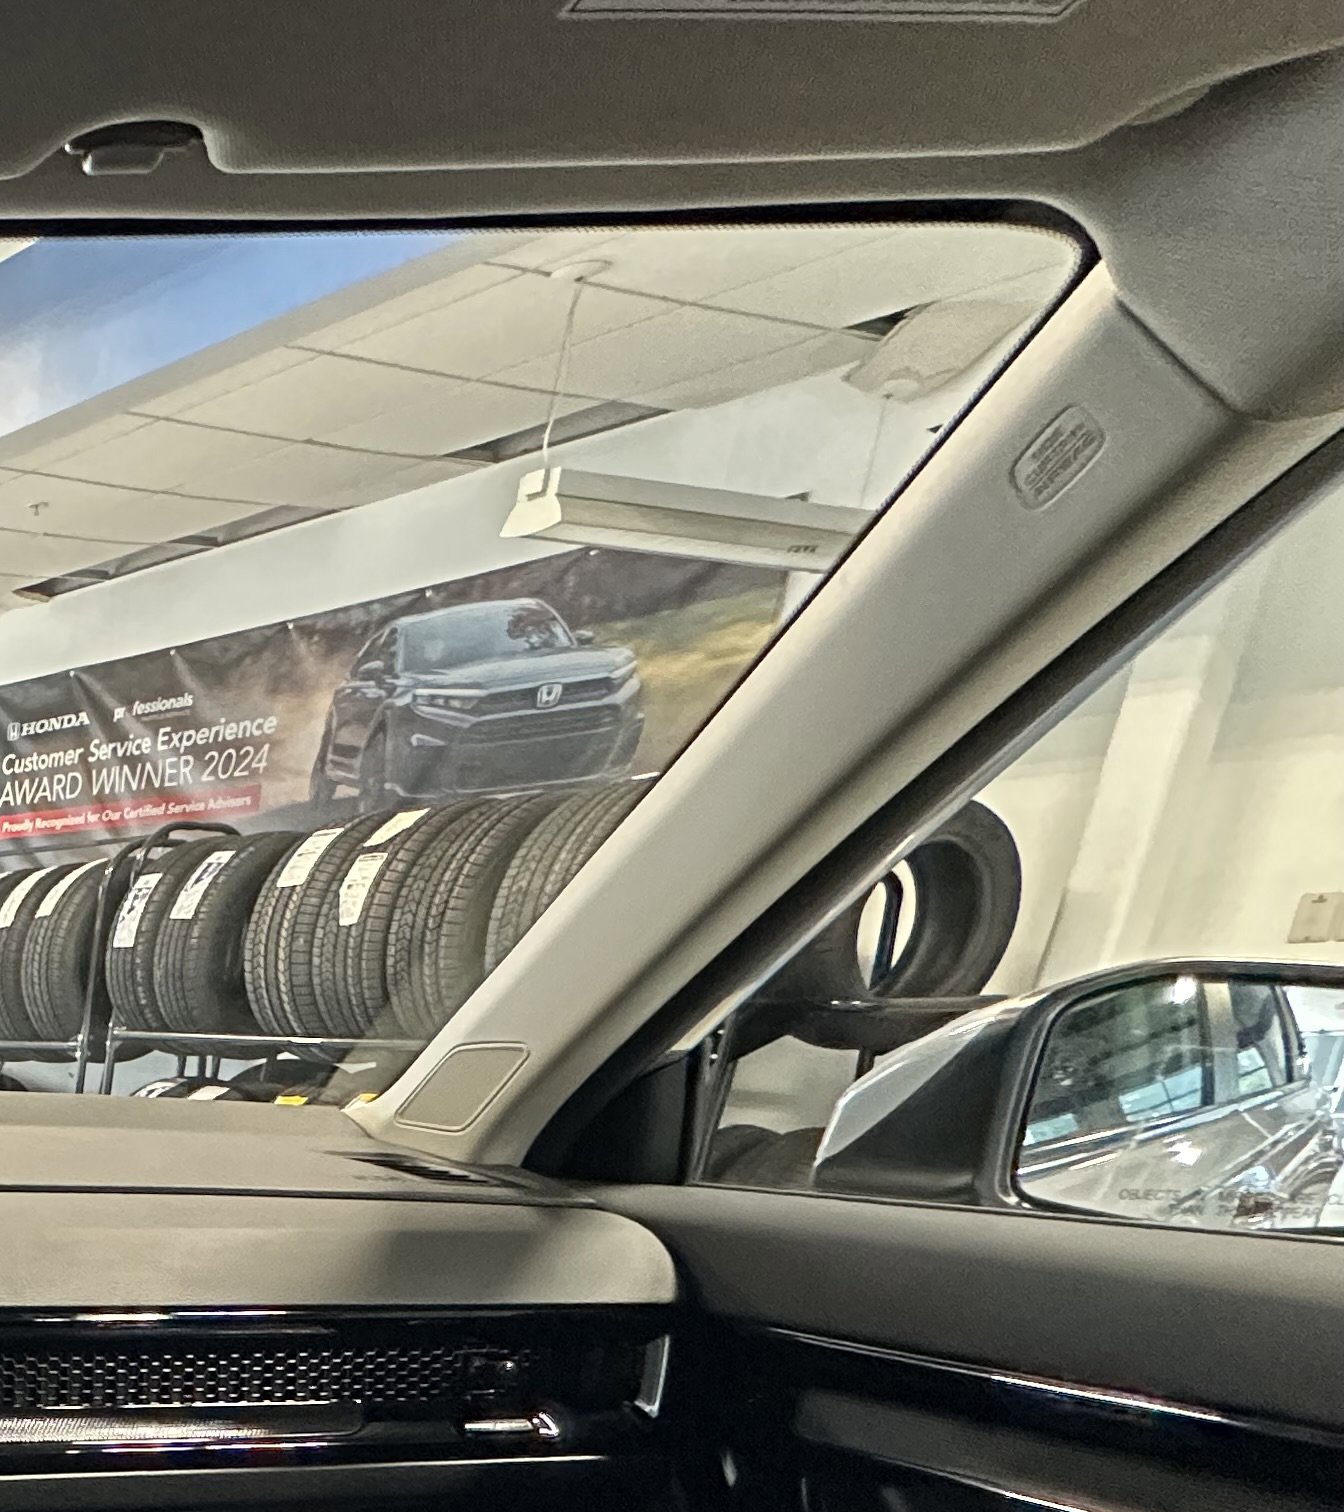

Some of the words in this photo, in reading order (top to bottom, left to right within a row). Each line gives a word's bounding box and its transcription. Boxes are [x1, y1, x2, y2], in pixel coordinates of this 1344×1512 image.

[1, 748, 84, 776] Customer
[87, 734, 153, 763] Service
[157, 715, 278, 753] Experience
[21, 711, 91, 737] HONDA
[92, 754, 195, 796] WINNER
[201, 743, 270, 783] 2024
[1, 818, 34, 835] Proudly
[35, 811, 86, 831] Recognized
[86, 810, 100, 825] for
[102, 808, 122, 821] Our
[123, 803, 165, 820] Certified
[167, 800, 206, 816] Service
[207, 795, 252, 811] Advisors
